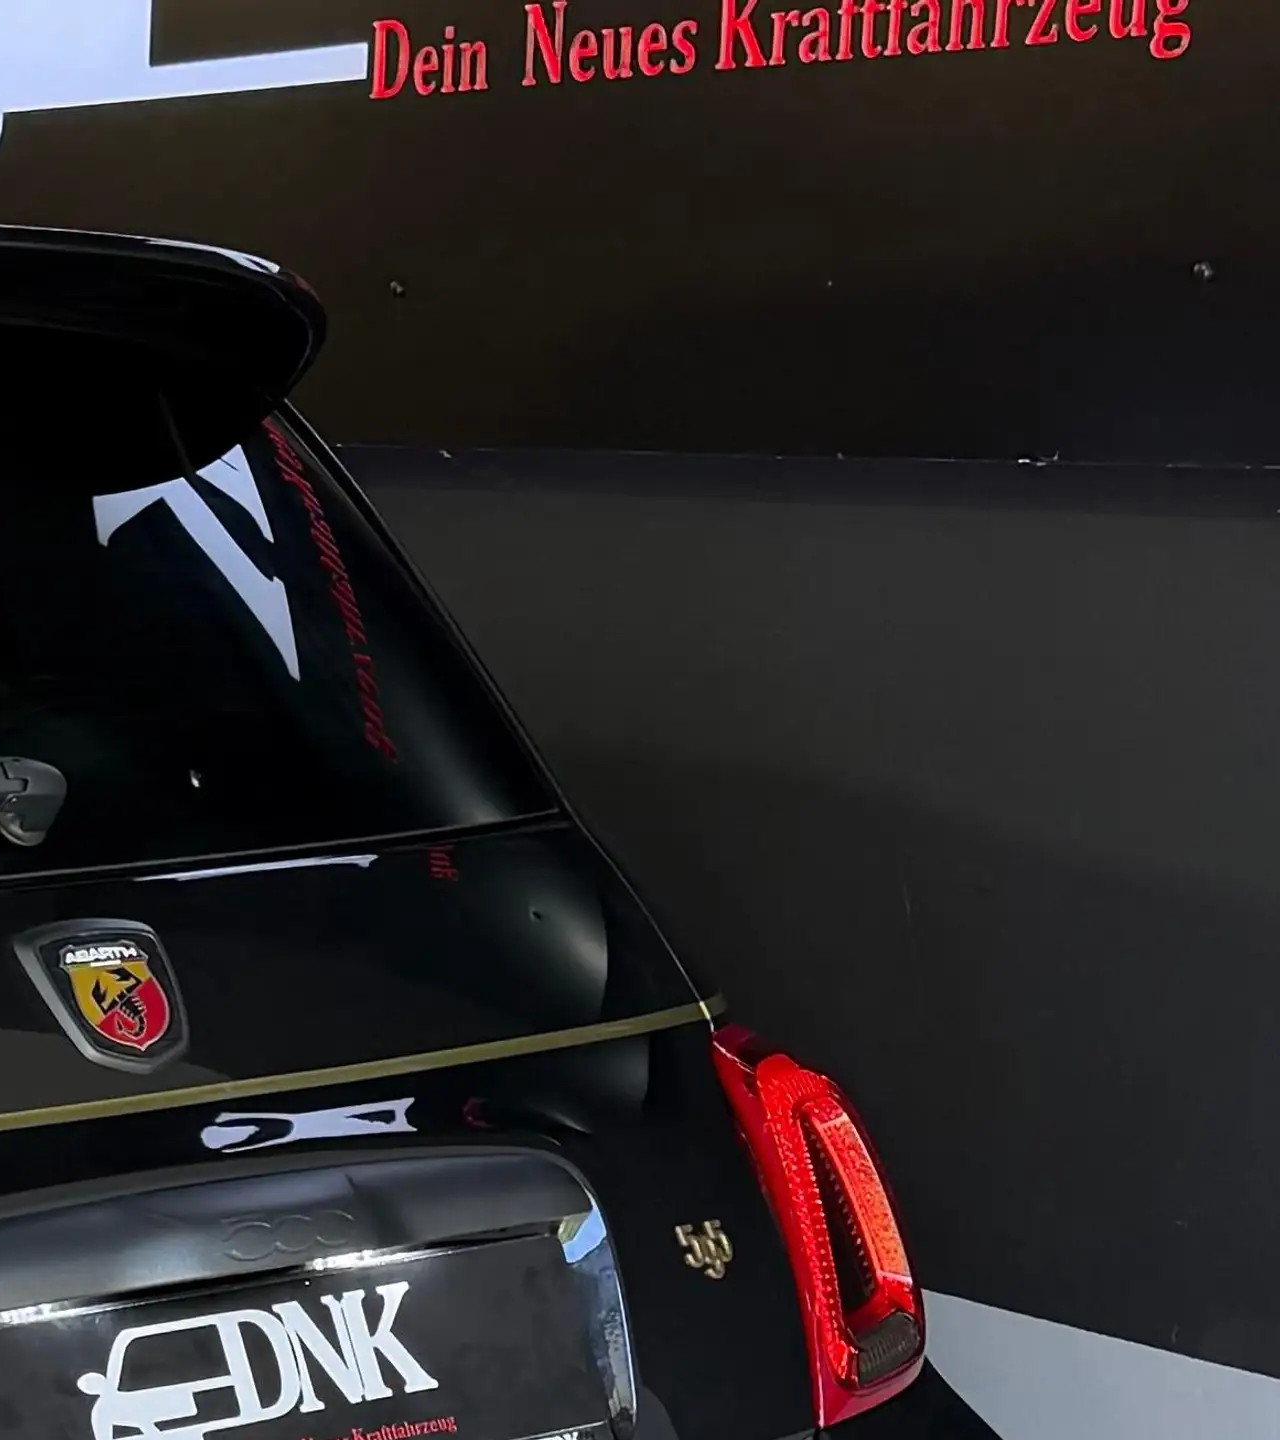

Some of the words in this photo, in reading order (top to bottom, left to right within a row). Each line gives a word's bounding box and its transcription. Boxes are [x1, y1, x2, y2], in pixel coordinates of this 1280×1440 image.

[369, 19, 489, 100] Dein
[521, 1, 699, 87] Neues
[65, 946, 138, 964] ABARTH
[216, 1281, 440, 1423] DNK
